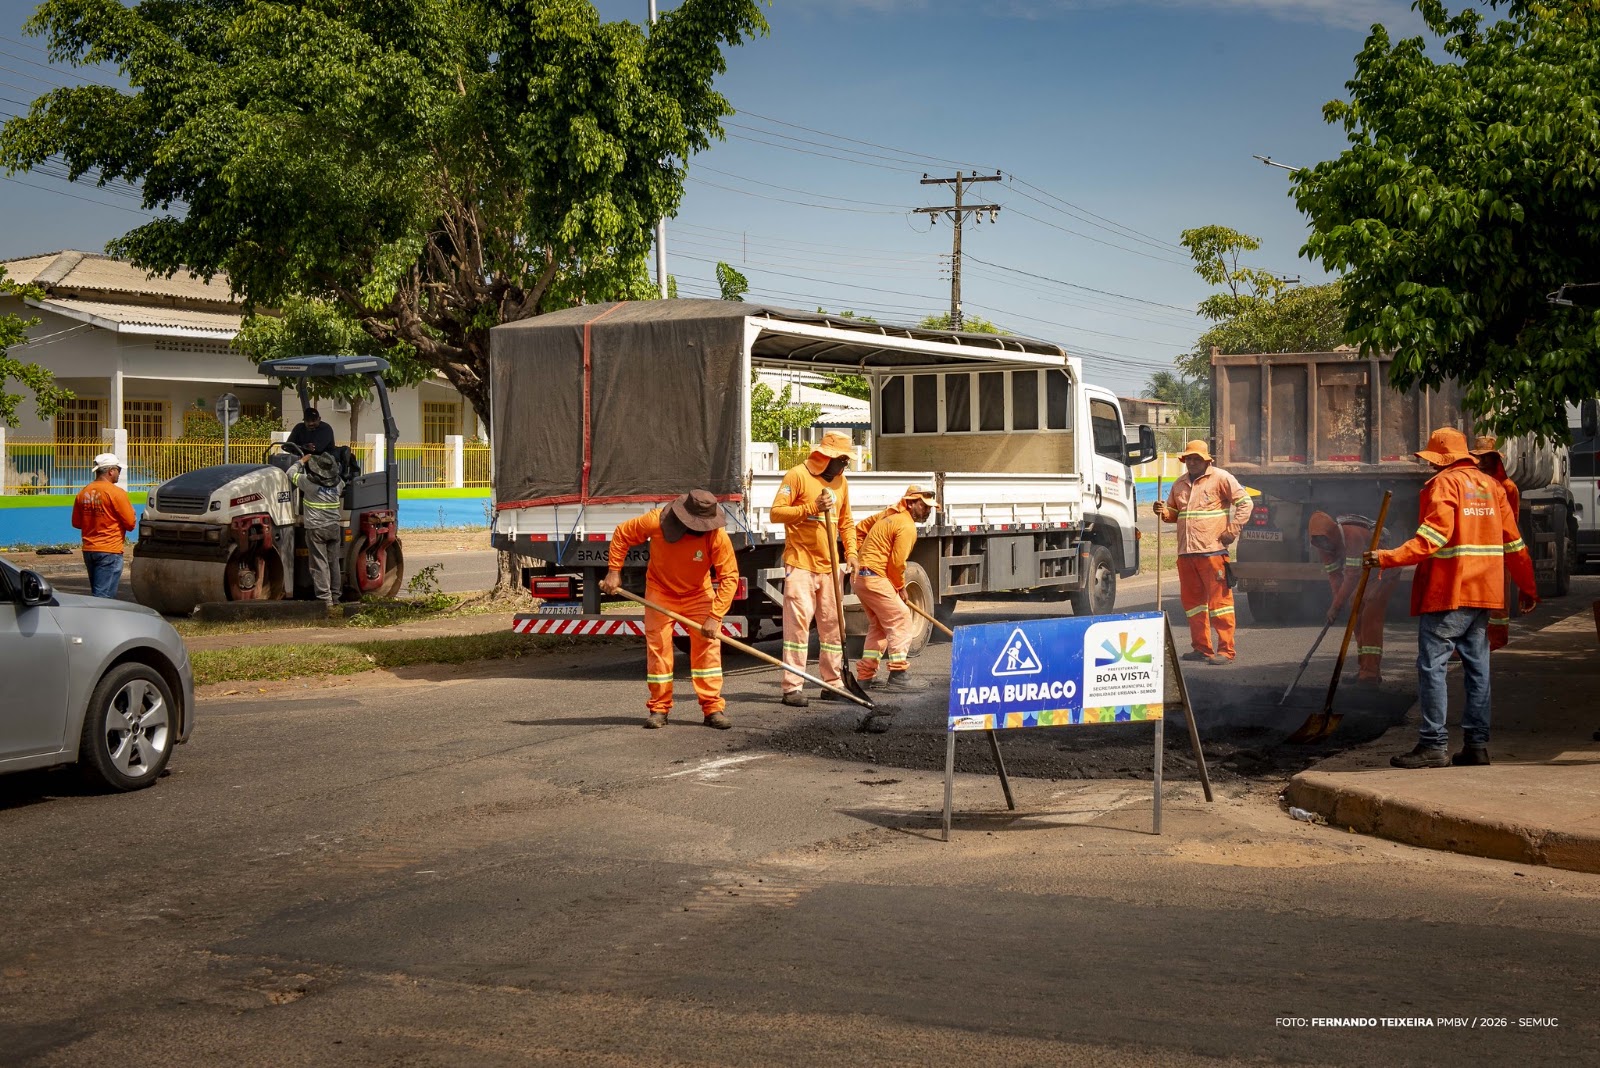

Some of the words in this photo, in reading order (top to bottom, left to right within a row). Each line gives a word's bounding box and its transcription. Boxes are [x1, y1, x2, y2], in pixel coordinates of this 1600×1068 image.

[578, 550, 650, 561] BRASRRO
[1096, 673, 1118, 683] BOA
[1120, 671, 1150, 681] VISTA
[957, 686, 1001, 705] TAPA
[1004, 680, 1077, 702] BURACO
